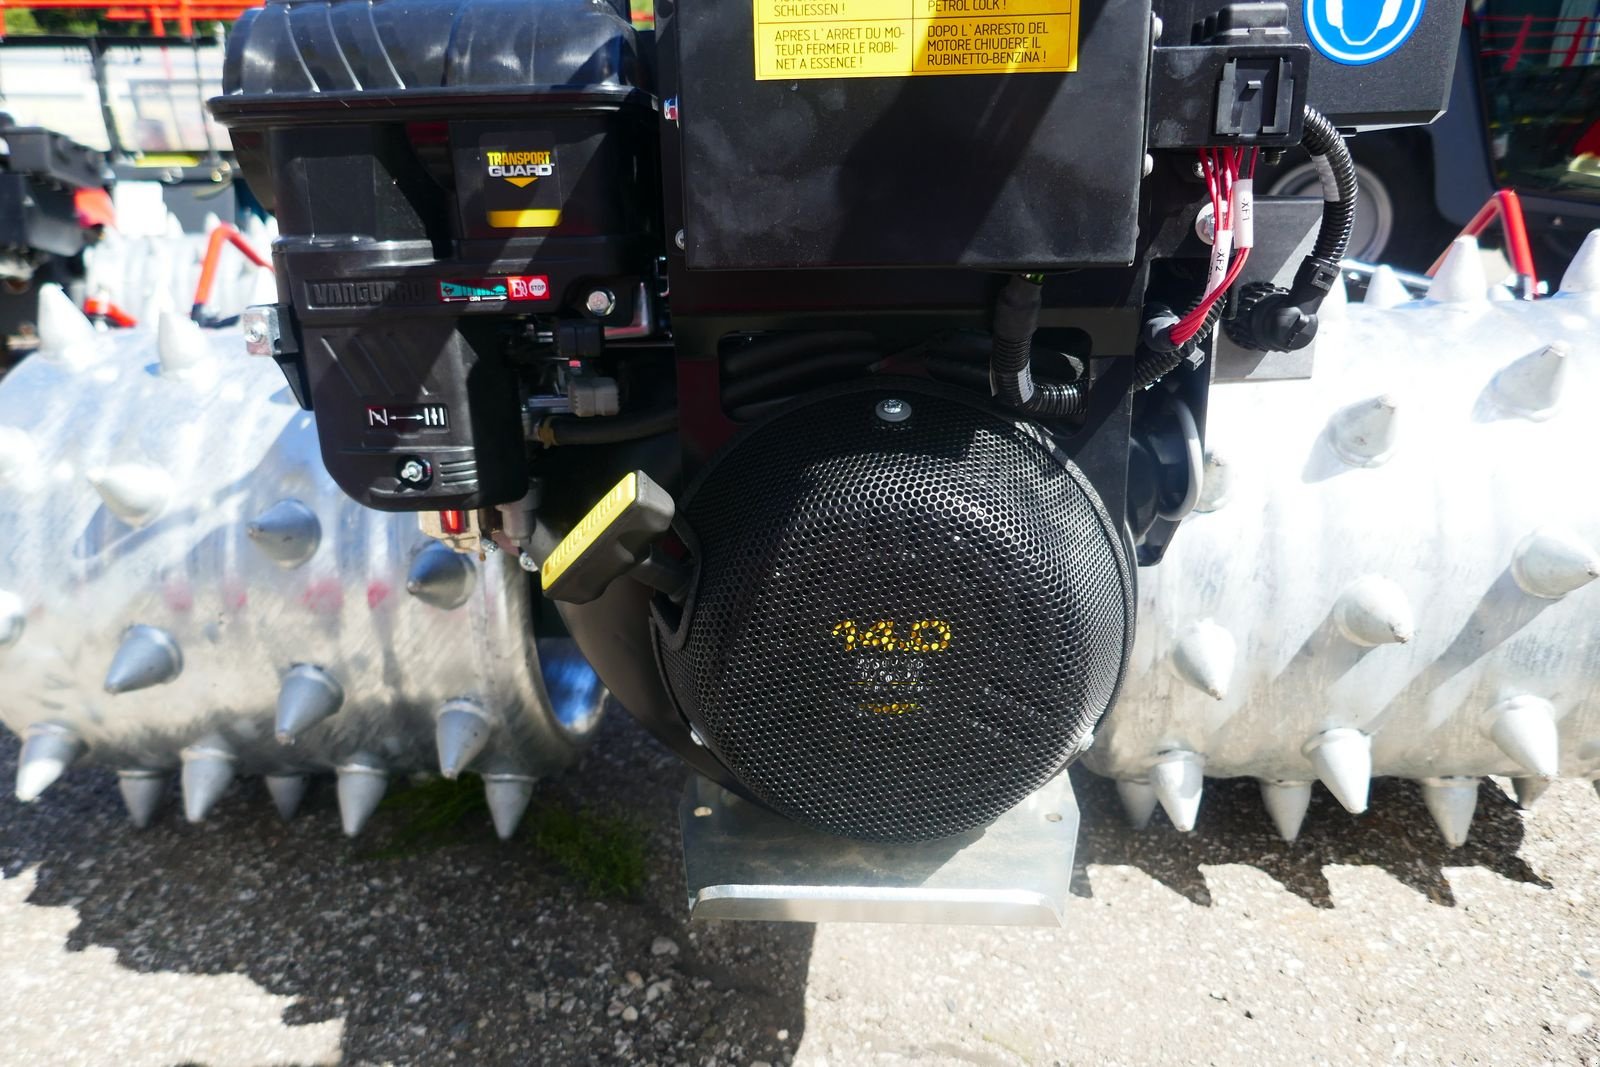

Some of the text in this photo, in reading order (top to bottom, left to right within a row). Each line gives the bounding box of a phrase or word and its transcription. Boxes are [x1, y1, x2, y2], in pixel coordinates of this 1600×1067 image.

[774, 4, 838, 17] SCHLIESSEN
[928, 0, 970, 12] PETROL
[775, 29, 811, 42] APRES
[865, 27, 881, 40] DU
[884, 26, 905, 39] MO-
[927, 25, 958, 38] DOPO
[1028, 21, 1049, 34] DEL
[776, 41, 899, 57] TEUR FERMER LE ROBI-
[927, 36, 1041, 52] MOTORE CHIUDERE IL
[776, 58, 796, 71] NET
[799, 57, 807, 70] A
[810, 56, 857, 70] ESSENCE
[927, 51, 1040, 66] RUBINETTO-BENZINA
[486, 151, 551, 166] TRANSPORT
[488, 164, 553, 177] GUARD
[313, 281, 425, 304] VANGUARD
[831, 620, 951, 651] 14.0
